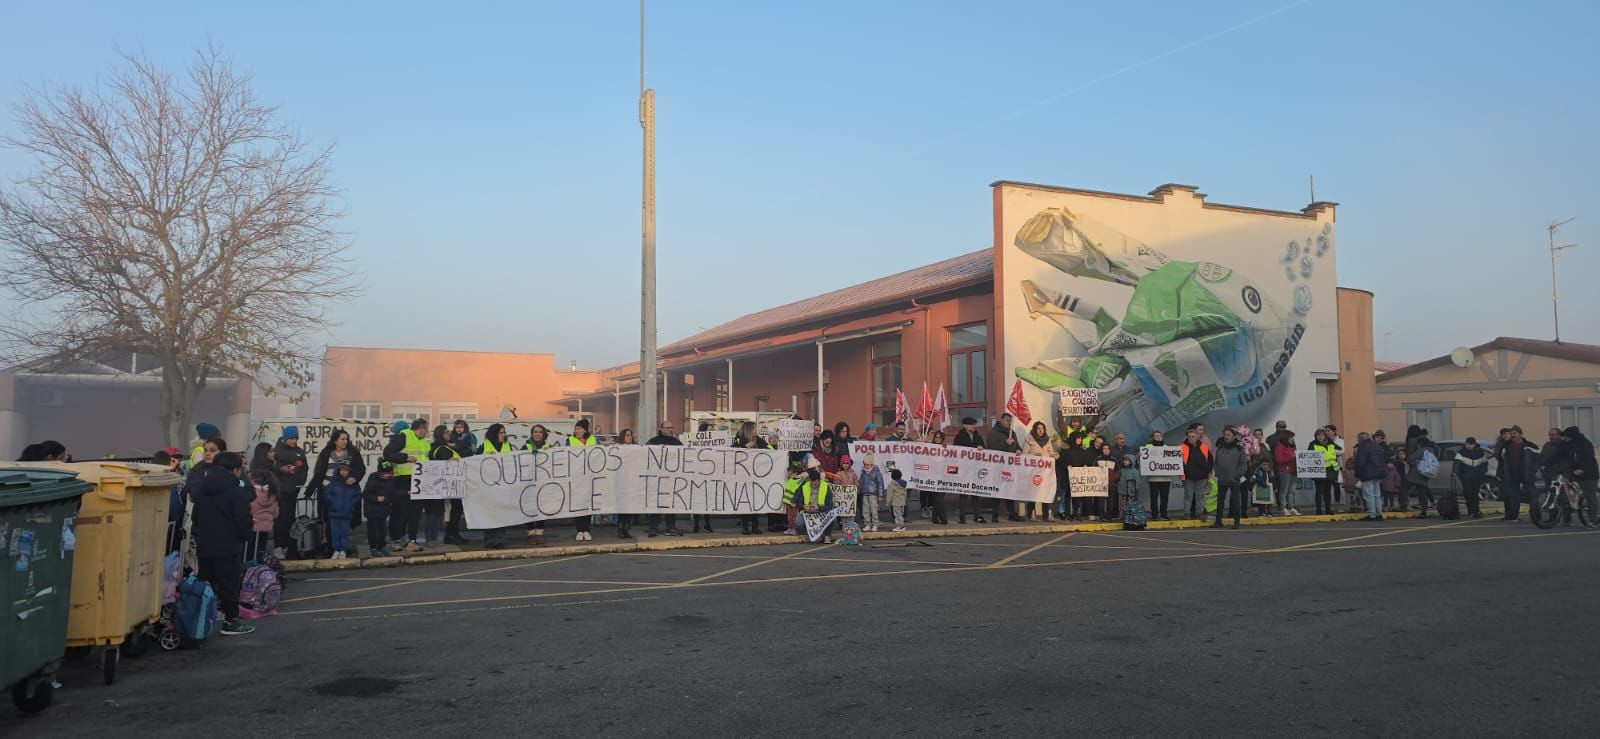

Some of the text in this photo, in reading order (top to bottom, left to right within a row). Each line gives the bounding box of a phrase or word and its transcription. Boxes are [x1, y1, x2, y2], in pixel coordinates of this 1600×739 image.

[306, 426, 344, 439] RUR
[356, 426, 377, 438] NO
[696, 432, 712, 440] COLE
[303, 441, 319, 454] DE
[1142, 448, 1149, 460] 3
[855, 445, 1052, 469] POR LA EDUCACIÓN PÚBLICA DE LEÓN
[414, 463, 423, 475] 3
[480, 447, 775, 487] QUEREMOS NUESTRO
[412, 479, 421, 494] 3
[937, 479, 970, 488] Personal
[972, 484, 1000, 492] Docente
[519, 475, 785, 518] COLE TERMINADO
